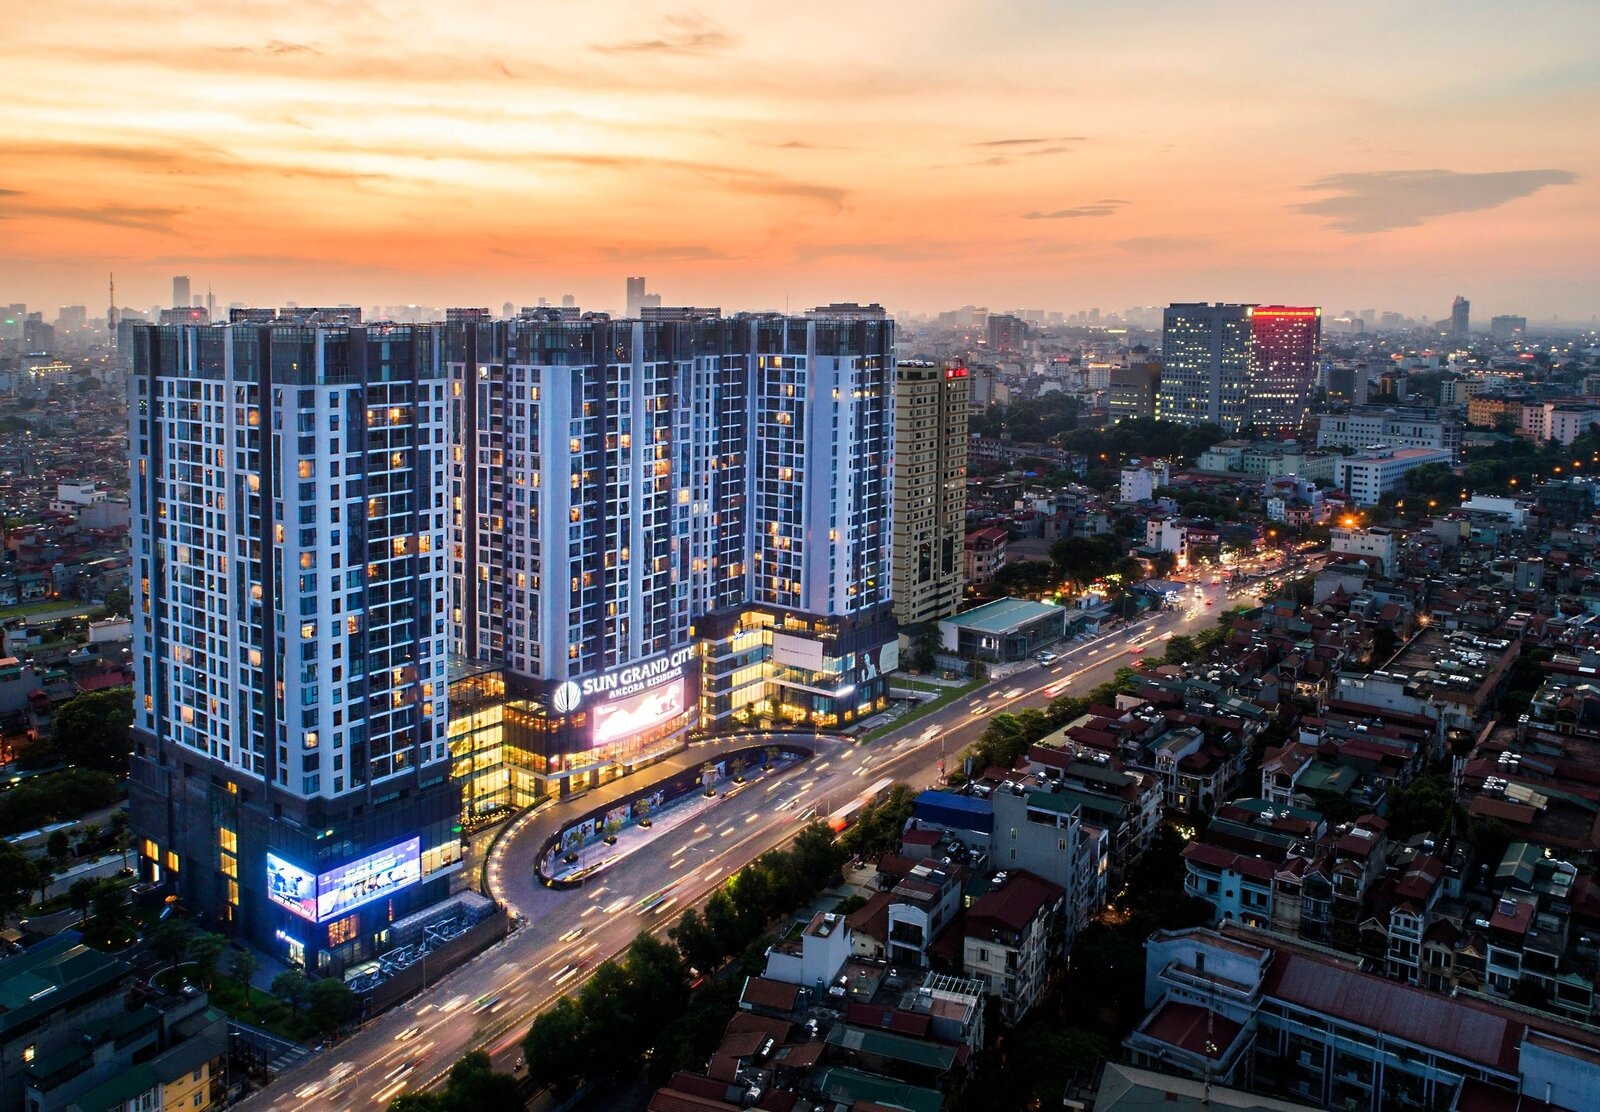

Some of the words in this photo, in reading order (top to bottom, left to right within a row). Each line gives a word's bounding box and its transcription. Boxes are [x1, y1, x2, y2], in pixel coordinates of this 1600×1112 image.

[583, 673, 617, 694] SUN
[620, 658, 669, 685] GRAND
[671, 646, 695, 666] CITY
[609, 683, 645, 698] ANCORA
[647, 667, 682, 686] RESIDENCE
